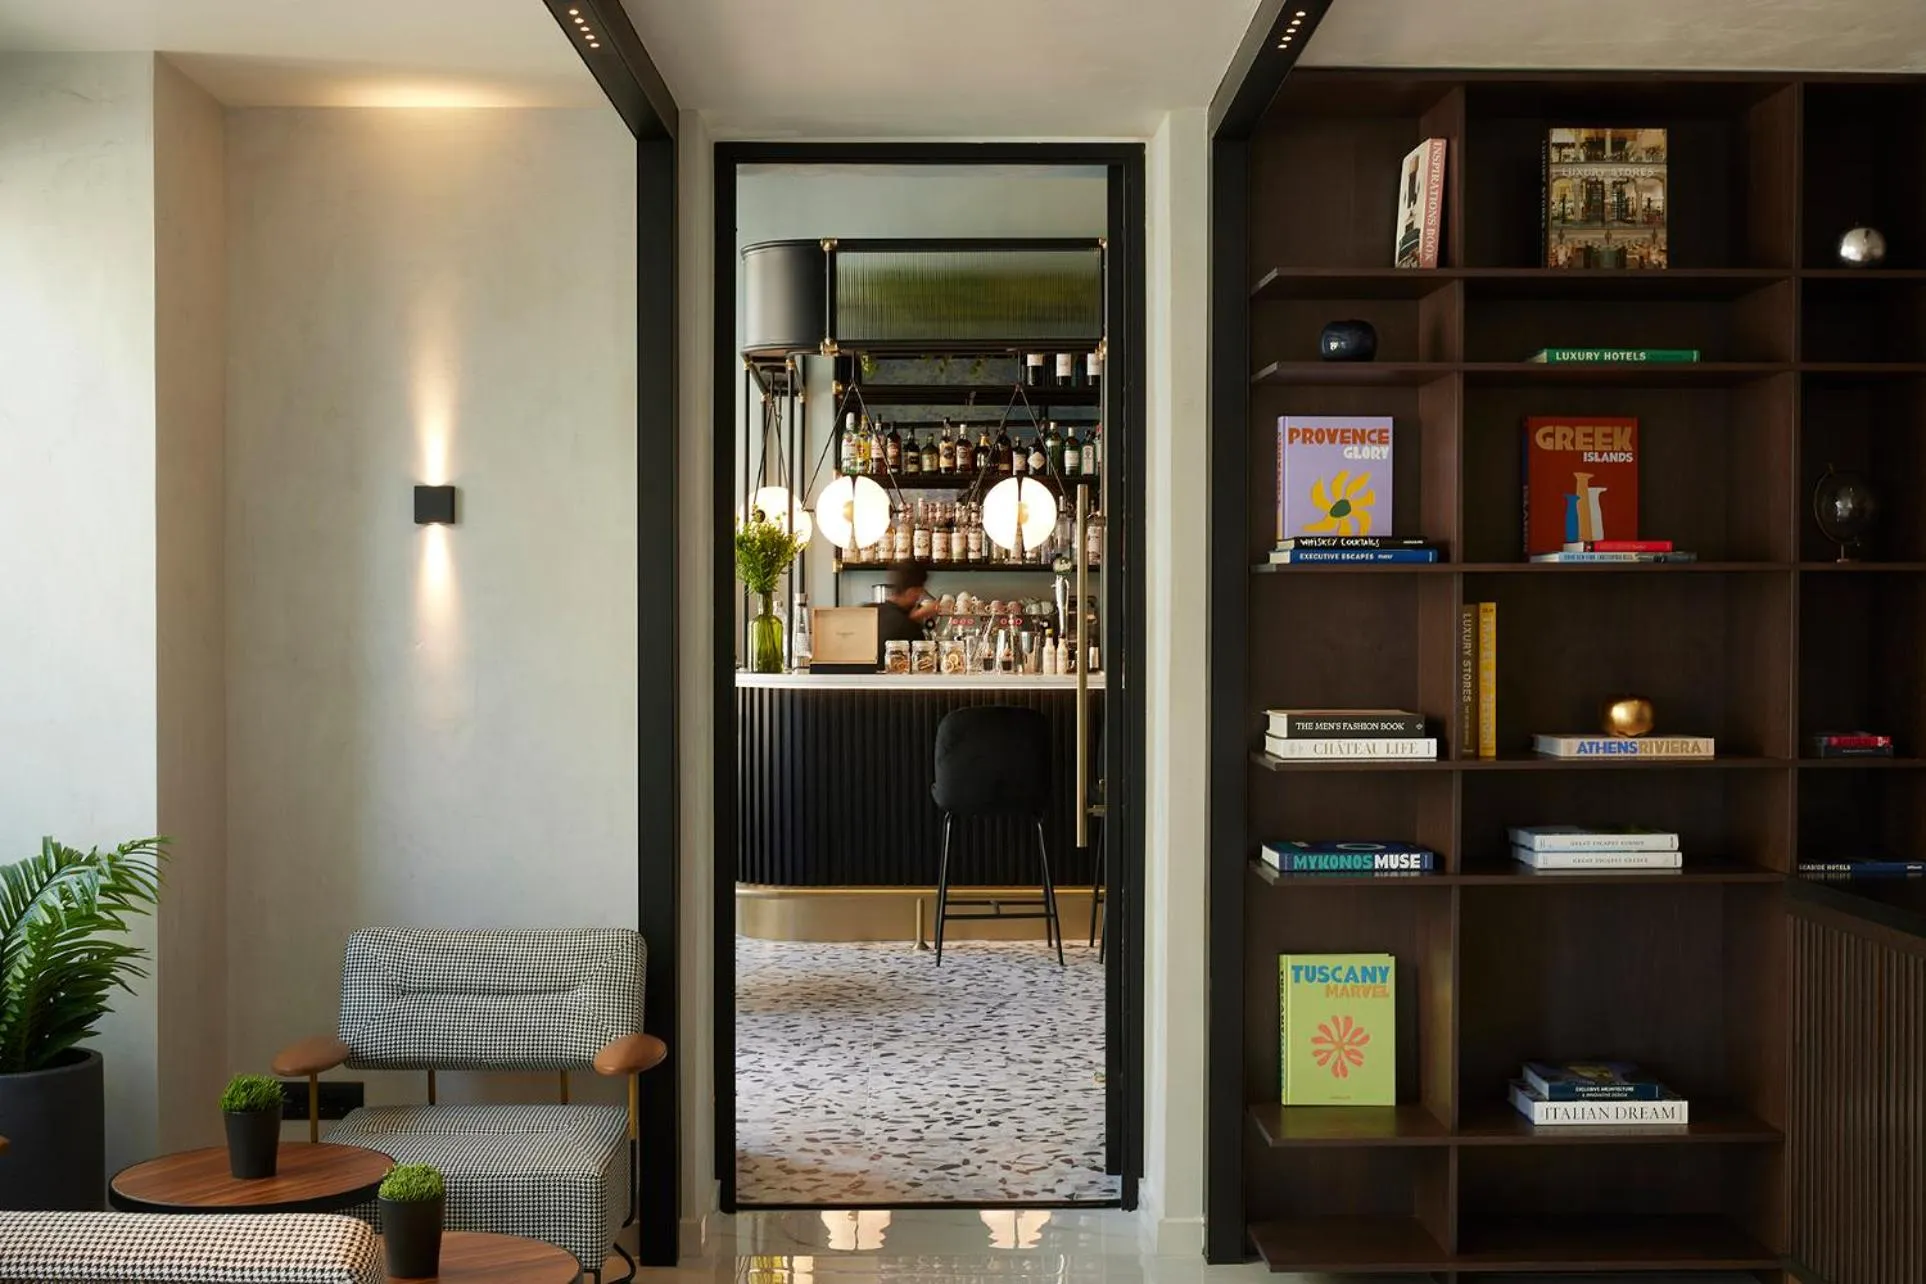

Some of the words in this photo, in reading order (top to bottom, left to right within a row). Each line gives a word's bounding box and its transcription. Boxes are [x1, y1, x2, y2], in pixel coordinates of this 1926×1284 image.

[1562, 168, 1605, 177] LUXURY
[1611, 168, 1655, 177] STORES
[1424, 228, 1436, 261] BOOK
[1555, 351, 1600, 361] LUXURY
[1604, 351, 1646, 361] HOTELS
[1288, 427, 1390, 445] PROVENCE
[1535, 426, 1633, 451] GREEK
[1343, 446, 1389, 460] GLORY
[1583, 452, 1633, 463] ISLANDS
[1299, 553, 1339, 561] EXECUTIVE
[1341, 553, 1375, 561] ESCAPES
[1462, 612, 1472, 656] LUXURY
[1462, 659, 1472, 703] STORES
[1296, 722, 1313, 731] THE
[1315, 722, 1342, 731] MEN'S
[1342, 722, 1380, 731] FASHION
[1381, 722, 1405, 731] BOOK
[1386, 741, 1419, 756] LIFE
[1576, 741, 1638, 754] ATHENS
[1293, 855, 1374, 870] MYKONOS
[1374, 854, 1421, 870] MUSE
[1291, 965, 1391, 984] TUSCANY
[1325, 984, 1390, 999] MARVEL
[1545, 1106, 1611, 1120] ITALIAN
[1615, 1106, 1675, 1121] DREAM
